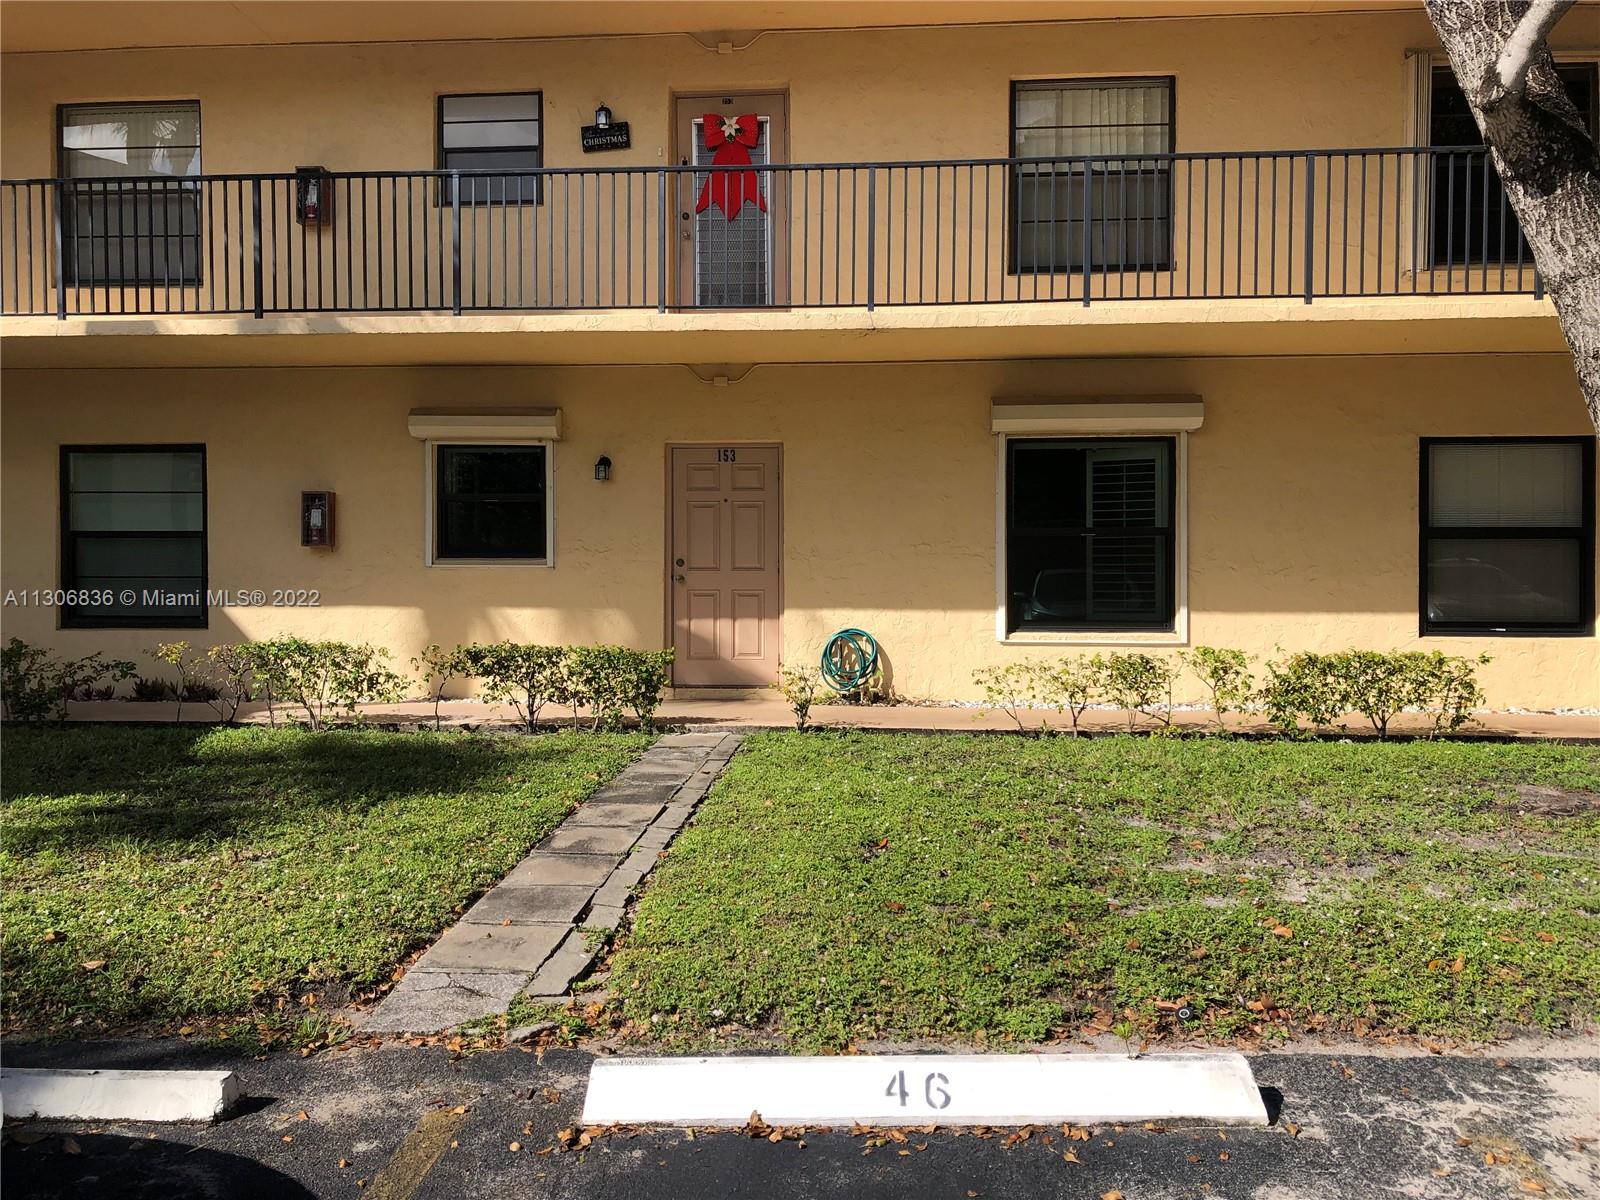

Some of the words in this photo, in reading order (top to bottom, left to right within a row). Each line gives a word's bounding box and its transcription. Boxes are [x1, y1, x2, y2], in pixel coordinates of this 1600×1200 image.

[583, 134, 628, 146] CHRISTMAS
[717, 449, 736, 462] 153
[885, 1069, 952, 1110] 46
